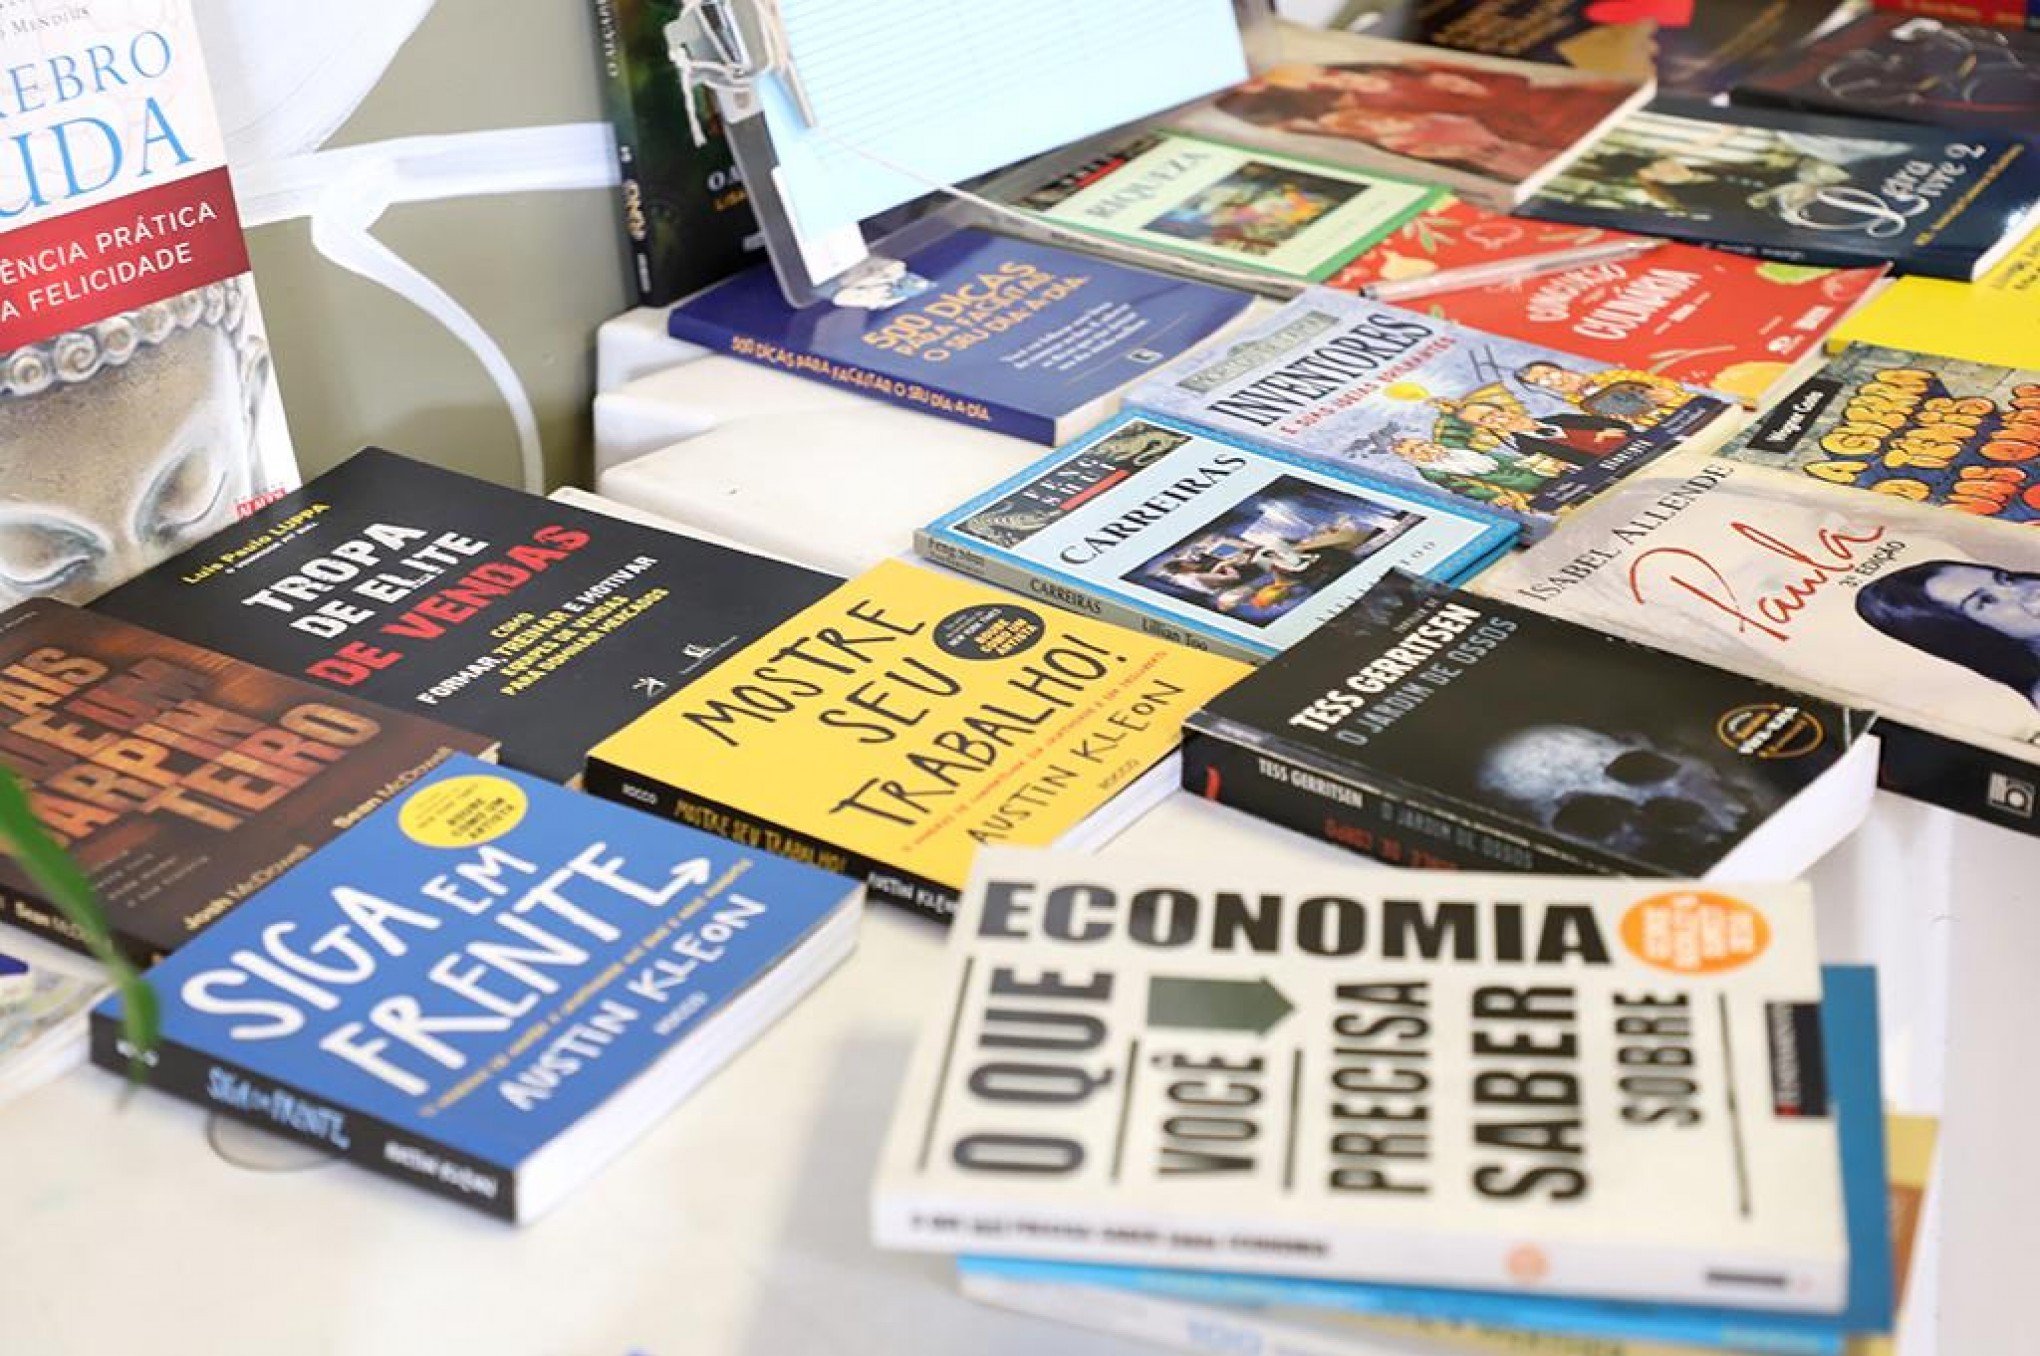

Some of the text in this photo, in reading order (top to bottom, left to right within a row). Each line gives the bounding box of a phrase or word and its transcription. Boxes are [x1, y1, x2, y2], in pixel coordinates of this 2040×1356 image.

[0, 30, 172, 118] EBRO
[28, 241, 193, 312] FELICIDADE
[95, 201, 218, 254] PRÁTICA
[862, 262, 1037, 350] 500 DICAS
[923, 349, 951, 362] O
[945, 327, 990, 350] SEU
[755, 341, 796, 367] DICAS
[796, 354, 830, 374] PARA
[894, 381, 907, 397] O
[907, 385, 930, 403] SEU
[1207, 313, 1436, 427] INVENTORES
[1764, 416, 1804, 443] Wagner
[1803, 460, 1869, 484] A
[269, 502, 332, 537] LUPPA
[1059, 453, 1247, 567] CARREIRAS
[1518, 463, 1734, 602] ISABEL ALLENDE
[241, 522, 428, 613] TROPA
[289, 599, 377, 640] DE
[353, 531, 490, 604] ELITE
[305, 640, 404, 688] DE
[380, 525, 591, 640] VENDAS
[489, 611, 536, 638] COMO
[1029, 576, 1101, 614] CARREIRAS
[1629, 521, 1885, 642] Paula
[0, 648, 109, 719] AIS
[415, 654, 509, 706] FORMAR,
[562, 597, 586, 614] E
[575, 554, 660, 608] MOTIVAR
[681, 598, 928, 748] MOSTRE
[1287, 689, 1366, 733] TESS
[1346, 602, 1483, 694] GERRITSEN
[1336, 729, 1370, 747] O
[1365, 678, 1436, 735] JARDIM
[1419, 662, 1464, 688] DE
[1448, 614, 1520, 666] OSSOS
[818, 655, 964, 745] SEU
[828, 632, 1130, 827] TRABALHO!
[28, 697, 266, 848] ARPIN
[140, 702, 382, 833] TEIRO
[966, 763, 1081, 846] AUSTIN
[1069, 678, 1187, 764] KLEON
[1258, 757, 1289, 783] TESS
[1290, 769, 1364, 810] GERRITSEN
[181, 885, 442, 1041] SIGA
[421, 844, 539, 917] EM
[319, 841, 703, 1097] FRENTE
[976, 880, 1611, 965] ECONOMIA
[499, 1000, 640, 1112] AUSTIN
[626, 892, 768, 1003] KLEON
[966, 965, 1116, 1104] QUE
[1153, 1050, 1266, 1178] VOCÊ
[1324, 979, 1432, 1196] PRECISA
[1470, 983, 1591, 1202] SABER
[1612, 989, 1703, 1130] SOBRE
[953, 1131, 1088, 1177] O
